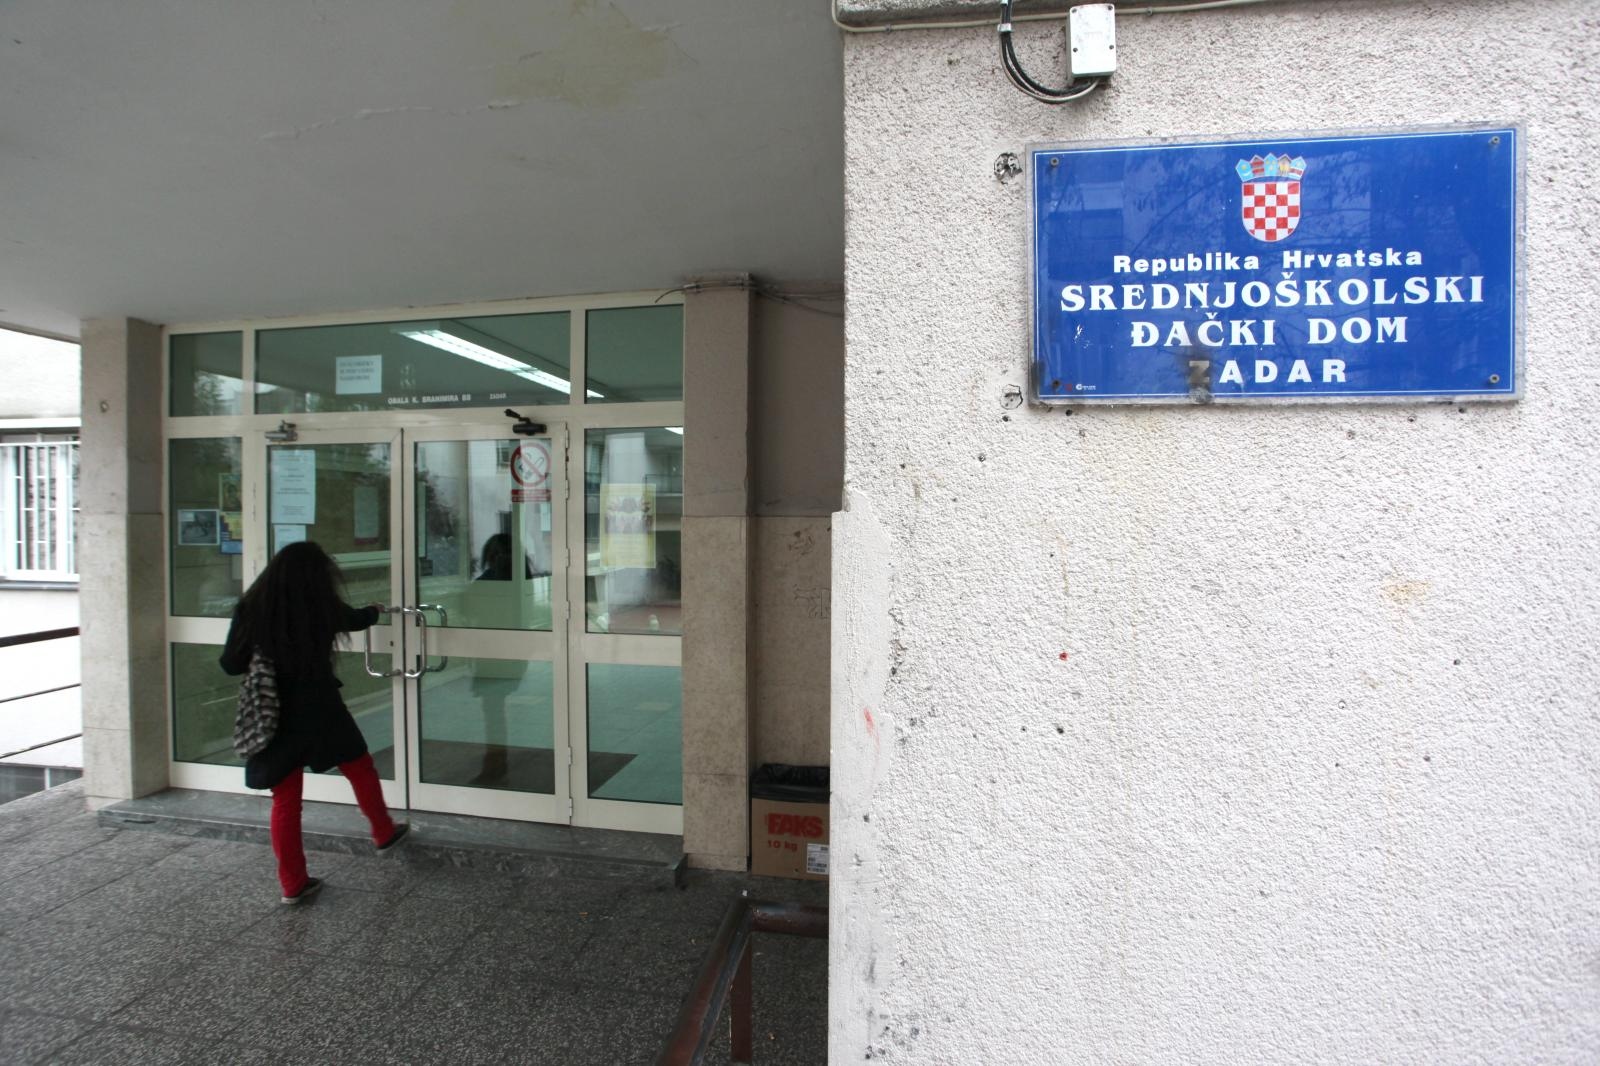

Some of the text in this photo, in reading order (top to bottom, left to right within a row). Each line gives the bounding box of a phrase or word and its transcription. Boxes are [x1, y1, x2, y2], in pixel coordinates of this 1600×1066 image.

[1113, 248, 1422, 274] Republika Hrvatska
[1060, 272, 1484, 312] SREDNJOŠKOLSKI
[1131, 312, 1408, 347] ĐAČKI DOM
[1188, 359, 1347, 384] ZADAR
